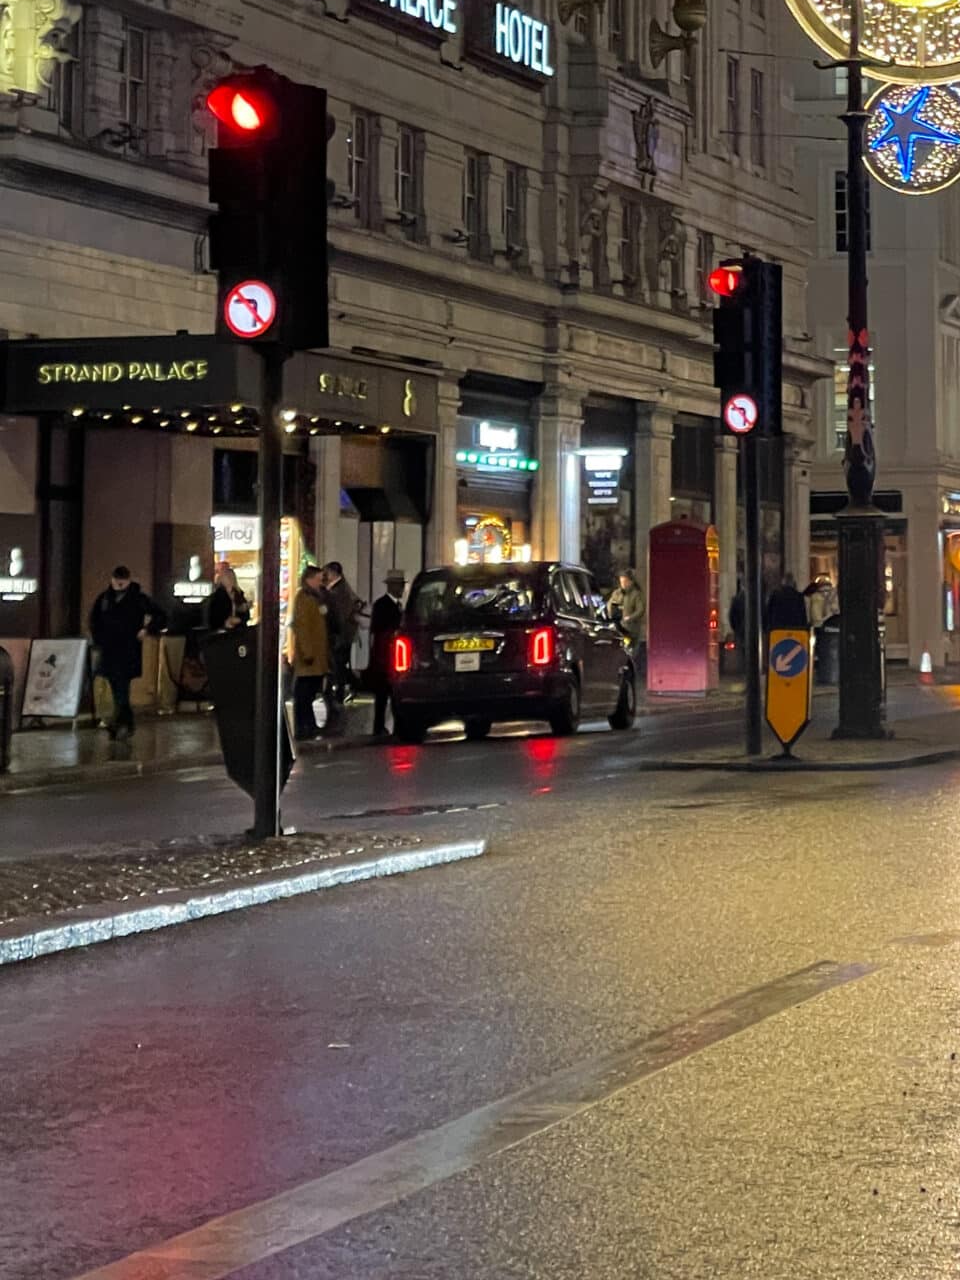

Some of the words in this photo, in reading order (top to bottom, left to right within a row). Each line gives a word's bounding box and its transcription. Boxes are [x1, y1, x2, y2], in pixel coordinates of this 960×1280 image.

[496, 3, 554, 76] HOTEL
[39, 363, 123, 384] STRAND
[128, 359, 208, 381] PALACE
